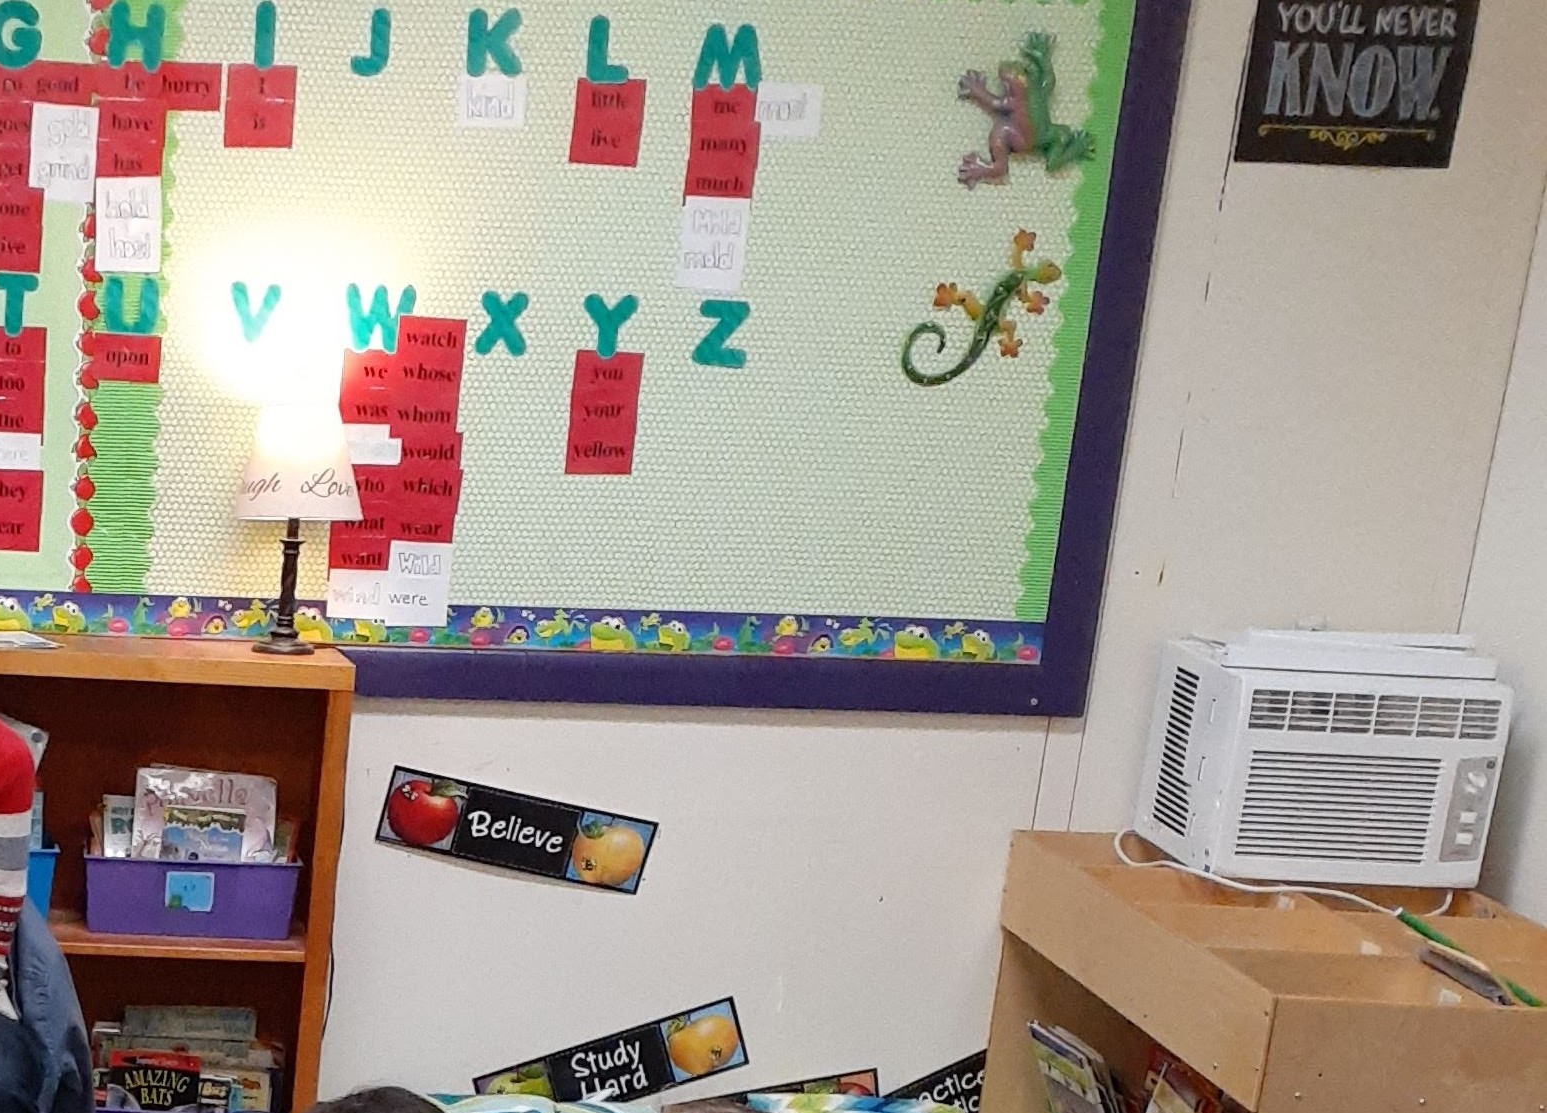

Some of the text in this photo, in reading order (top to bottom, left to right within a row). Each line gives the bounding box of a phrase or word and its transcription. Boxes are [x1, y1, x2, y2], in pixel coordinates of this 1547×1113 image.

[1278, 1, 1458, 37] YOU'LL NEVER
[105, 0, 168, 72] H
[253, 0, 278, 70] I
[350, 7, 392, 79] J
[465, 8, 523, 78] K
[585, 15, 629, 85] L
[690, 23, 762, 91] M
[36, 76, 80, 95] good
[162, 75, 211, 97] hurry
[112, 113, 154, 131] have
[252, 113, 267, 130] is
[589, 128, 622, 150] live
[701, 136, 748, 156] many
[113, 153, 142, 172] has
[695, 175, 745, 194] much
[102, 274, 161, 336] U
[230, 280, 283, 343] V
[344, 283, 417, 353] W
[473, 290, 530, 359] X
[582, 292, 640, 359] Y
[690, 298, 751, 370] Z
[405, 330, 459, 351] watch
[105, 349, 151, 370] upon
[363, 364, 390, 381] we
[402, 361, 458, 384] whose
[590, 366, 625, 385] you
[354, 401, 391, 418] was
[397, 404, 452, 425] whom
[582, 403, 626, 422] your
[401, 443, 456, 462] would
[571, 440, 628, 459] yellow
[402, 477, 454, 498] which
[400, 518, 443, 536] wear
[340, 551, 384, 568] want
[387, 592, 430, 607] were
[466, 809, 565, 854] Believe
[570, 1039, 641, 1079] Study
[123, 1068, 191, 1093] AMAZING
[140, 1087, 174, 1107] BATS
